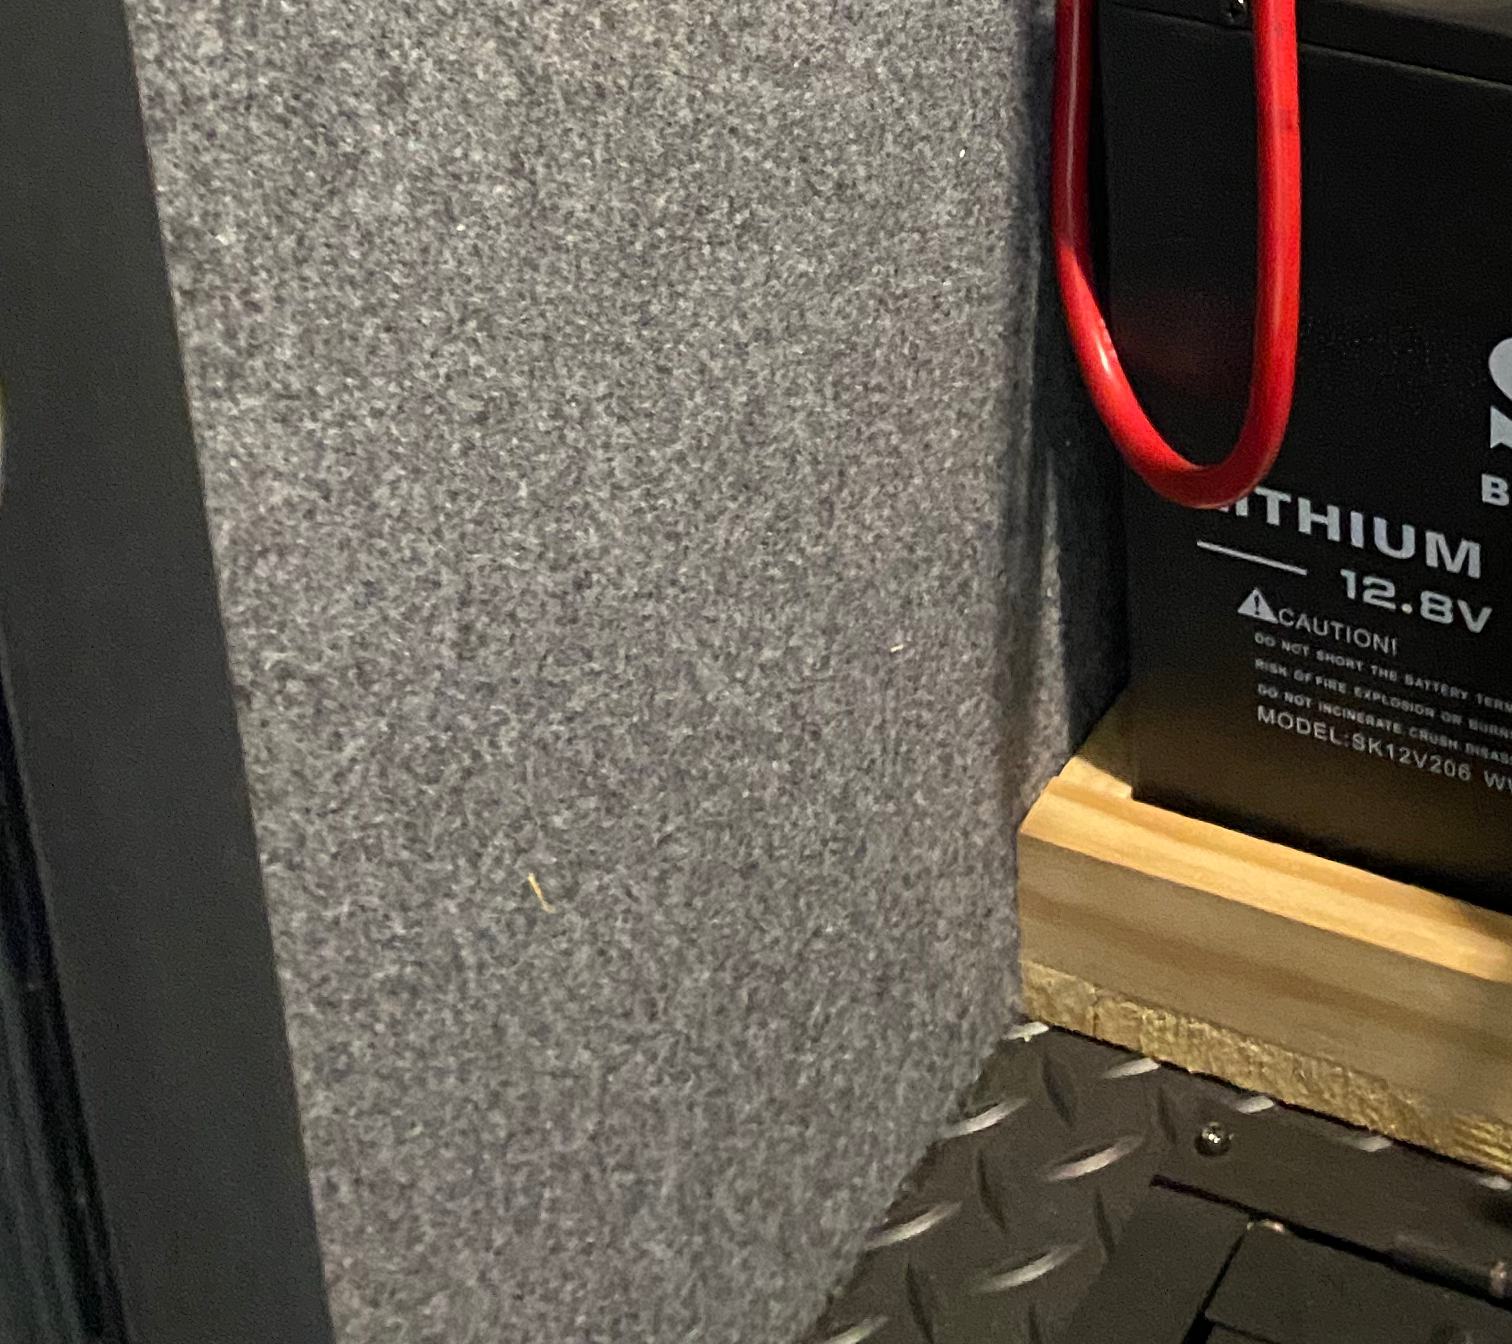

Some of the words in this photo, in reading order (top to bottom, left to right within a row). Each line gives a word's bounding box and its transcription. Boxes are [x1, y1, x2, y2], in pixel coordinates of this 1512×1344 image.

[1339, 568, 1494, 634] 12.8V
[1278, 607, 1398, 656] CAUTION!
[1254, 631, 1276, 648] DO
[1281, 639, 1310, 657] NOT
[1316, 649, 1364, 672] SHORT
[1371, 664, 1398, 682] THE
[1404, 673, 1469, 701] BATTERY
[1255, 658, 1288, 678] RISK
[1315, 675, 1347, 694] FIRE
[1284, 691, 1312, 708] NOT
[1318, 700, 1403, 734] INCINERATE
